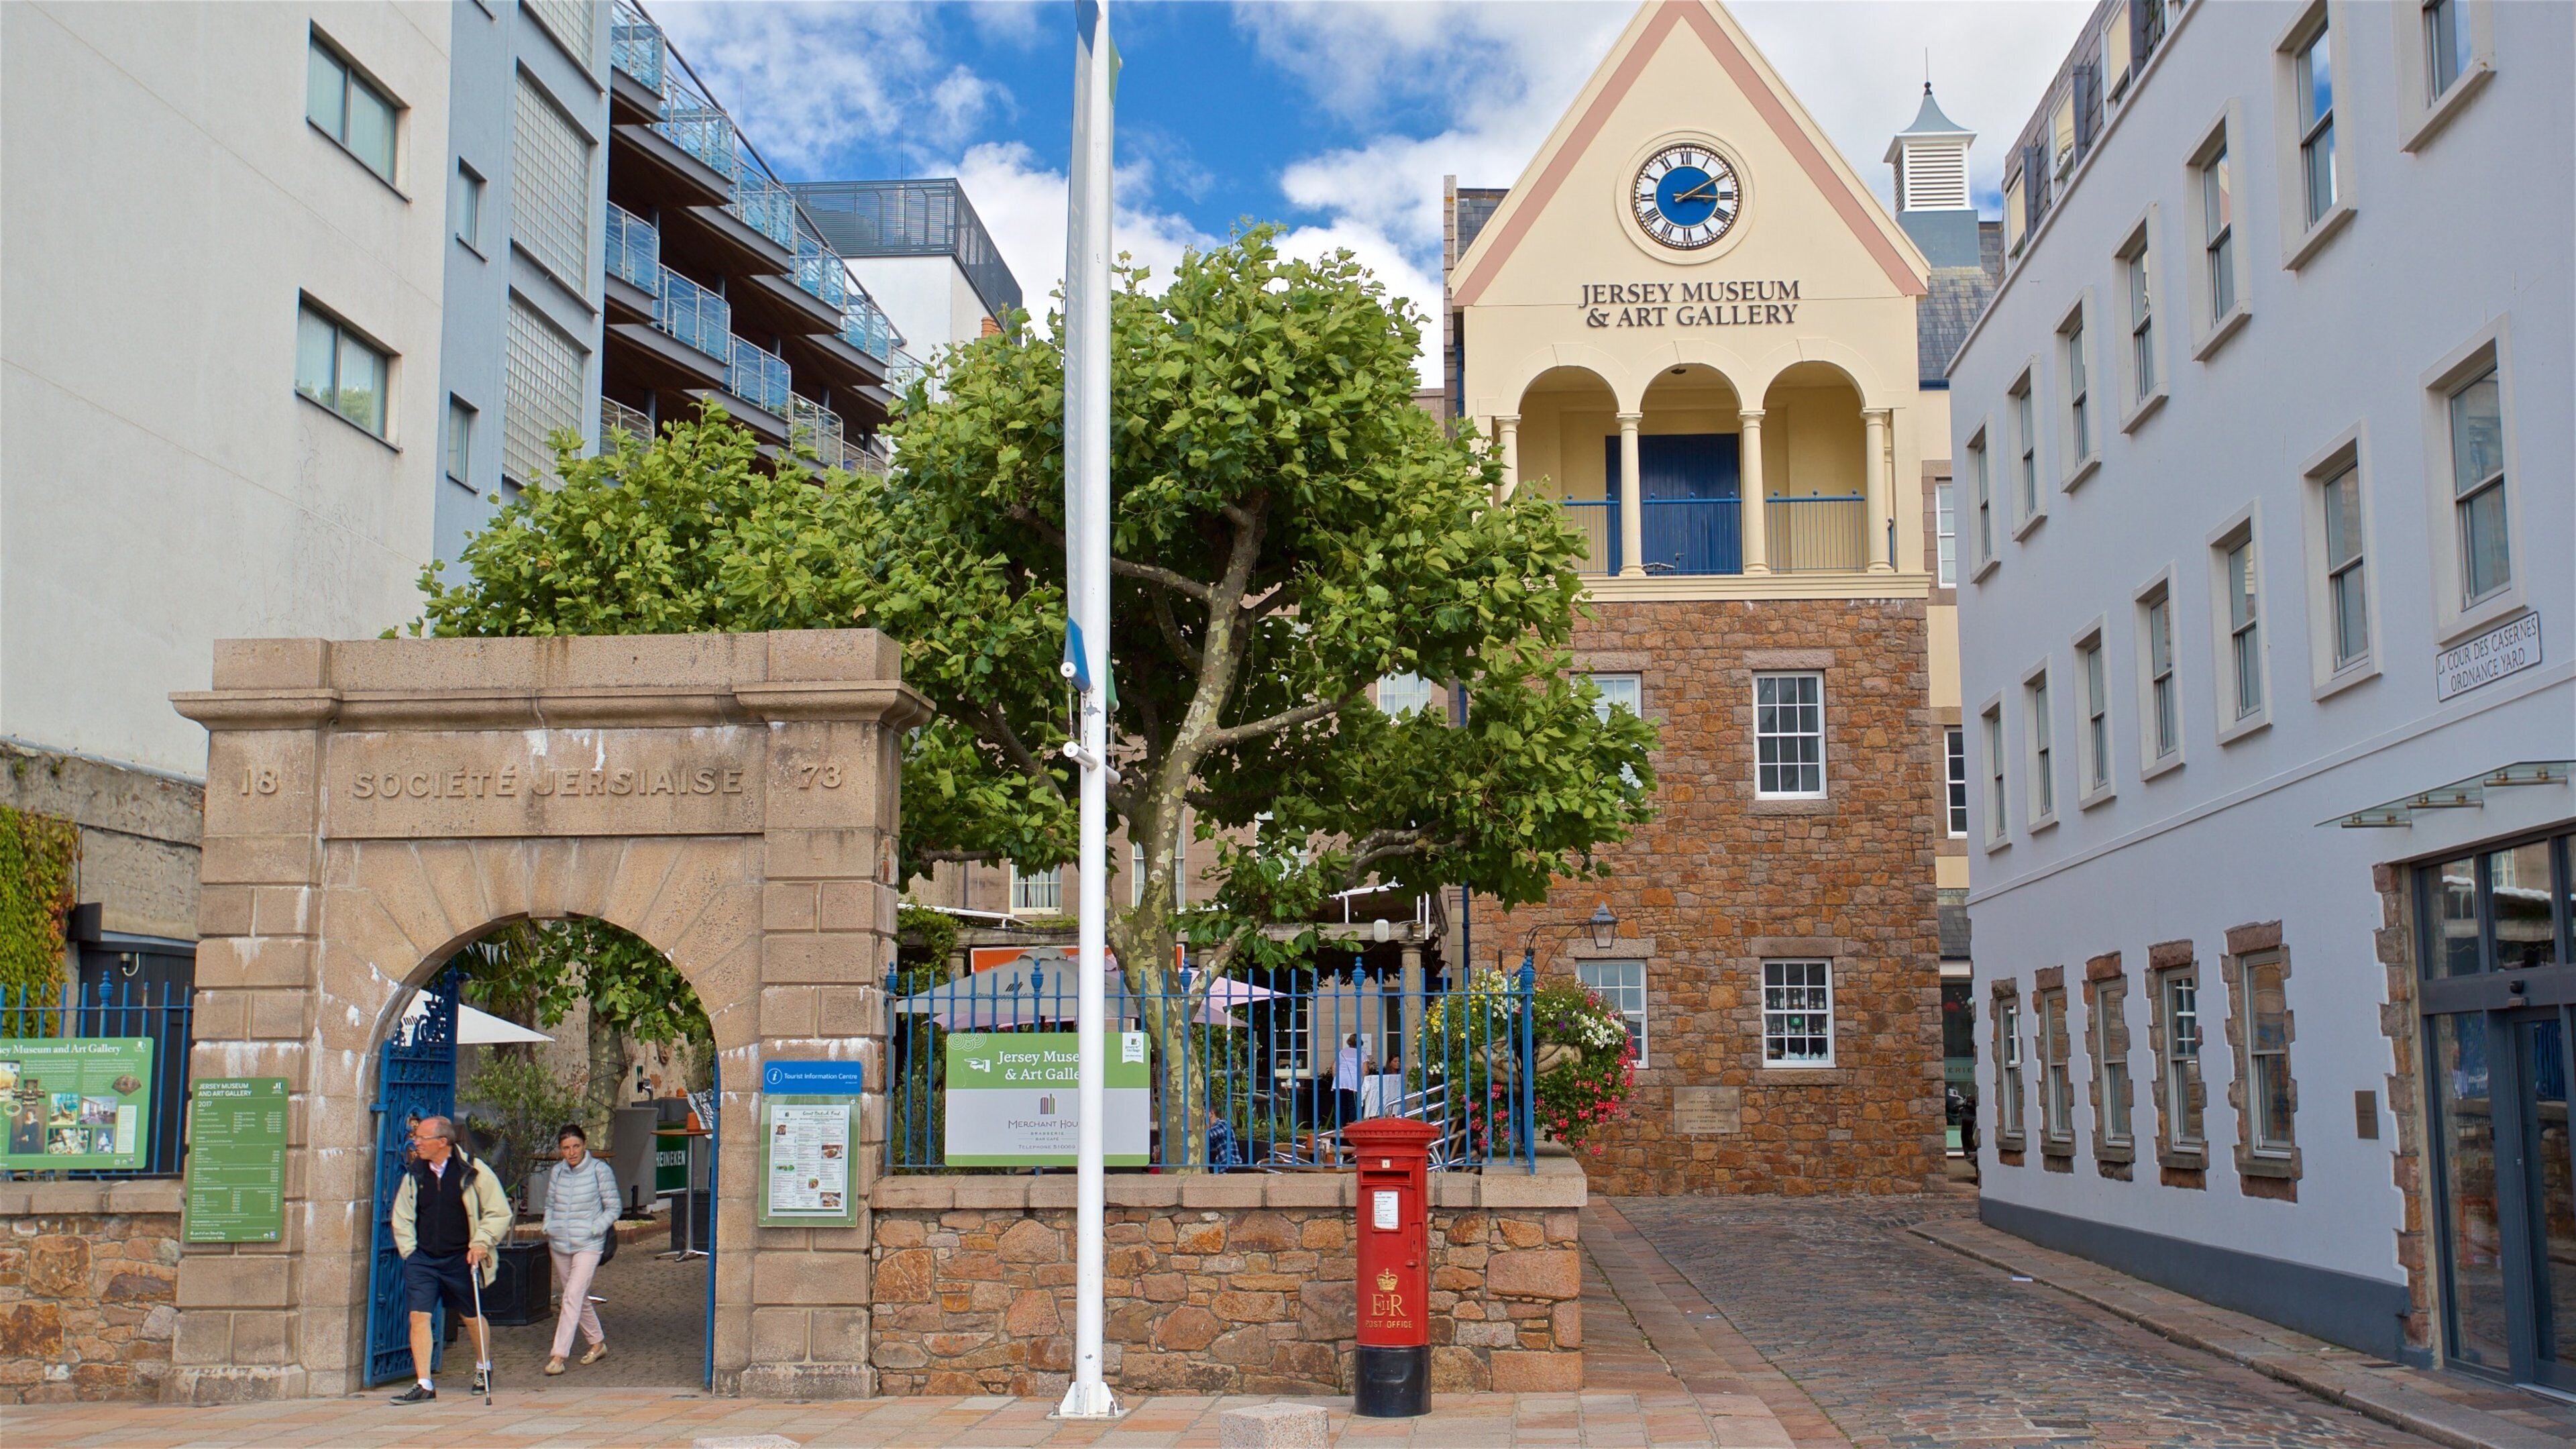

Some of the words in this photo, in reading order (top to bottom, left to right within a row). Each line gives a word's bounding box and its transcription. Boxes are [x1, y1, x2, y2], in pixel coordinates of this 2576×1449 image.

[1578, 282, 1674, 309] JERSEY
[1681, 280, 1801, 303] MUSEUM
[1587, 307, 1610, 327] &
[1617, 307, 1669, 327] ART
[1676, 304, 1799, 326] GALLERY
[2447, 647, 2471, 670] COUR
[2473, 638, 2489, 659] DES
[2491, 618, 2536, 652] CASERNES
[2450, 658, 2498, 692] ORDNANCE
[2500, 647, 2525, 672] YARD
[242, 769, 278, 795] 18
[353, 766, 517, 798] SOCIÉTÉ
[534, 767, 743, 796] JERSIAISE
[799, 763, 843, 790] 73
[13, 1044, 52, 1054] Museum
[53, 1044, 70, 1053] and
[70, 1044, 87, 1053] Art
[88, 1044, 122, 1056] Gallery
[997, 1051, 1040, 1067] Jersey
[1043, 1051, 1079, 1062] Muse
[1005, 1068, 1017, 1080] &
[1020, 1068, 1042, 1080] Art
[1045, 1067, 1079, 1080] Galle
[1008, 1120, 1057, 1129] MERCHANT
[1060, 1120, 1079, 1129] HOU
[1365, 1320, 1383, 1329] POST
[1387, 1320, 1413, 1329] OFFICE
